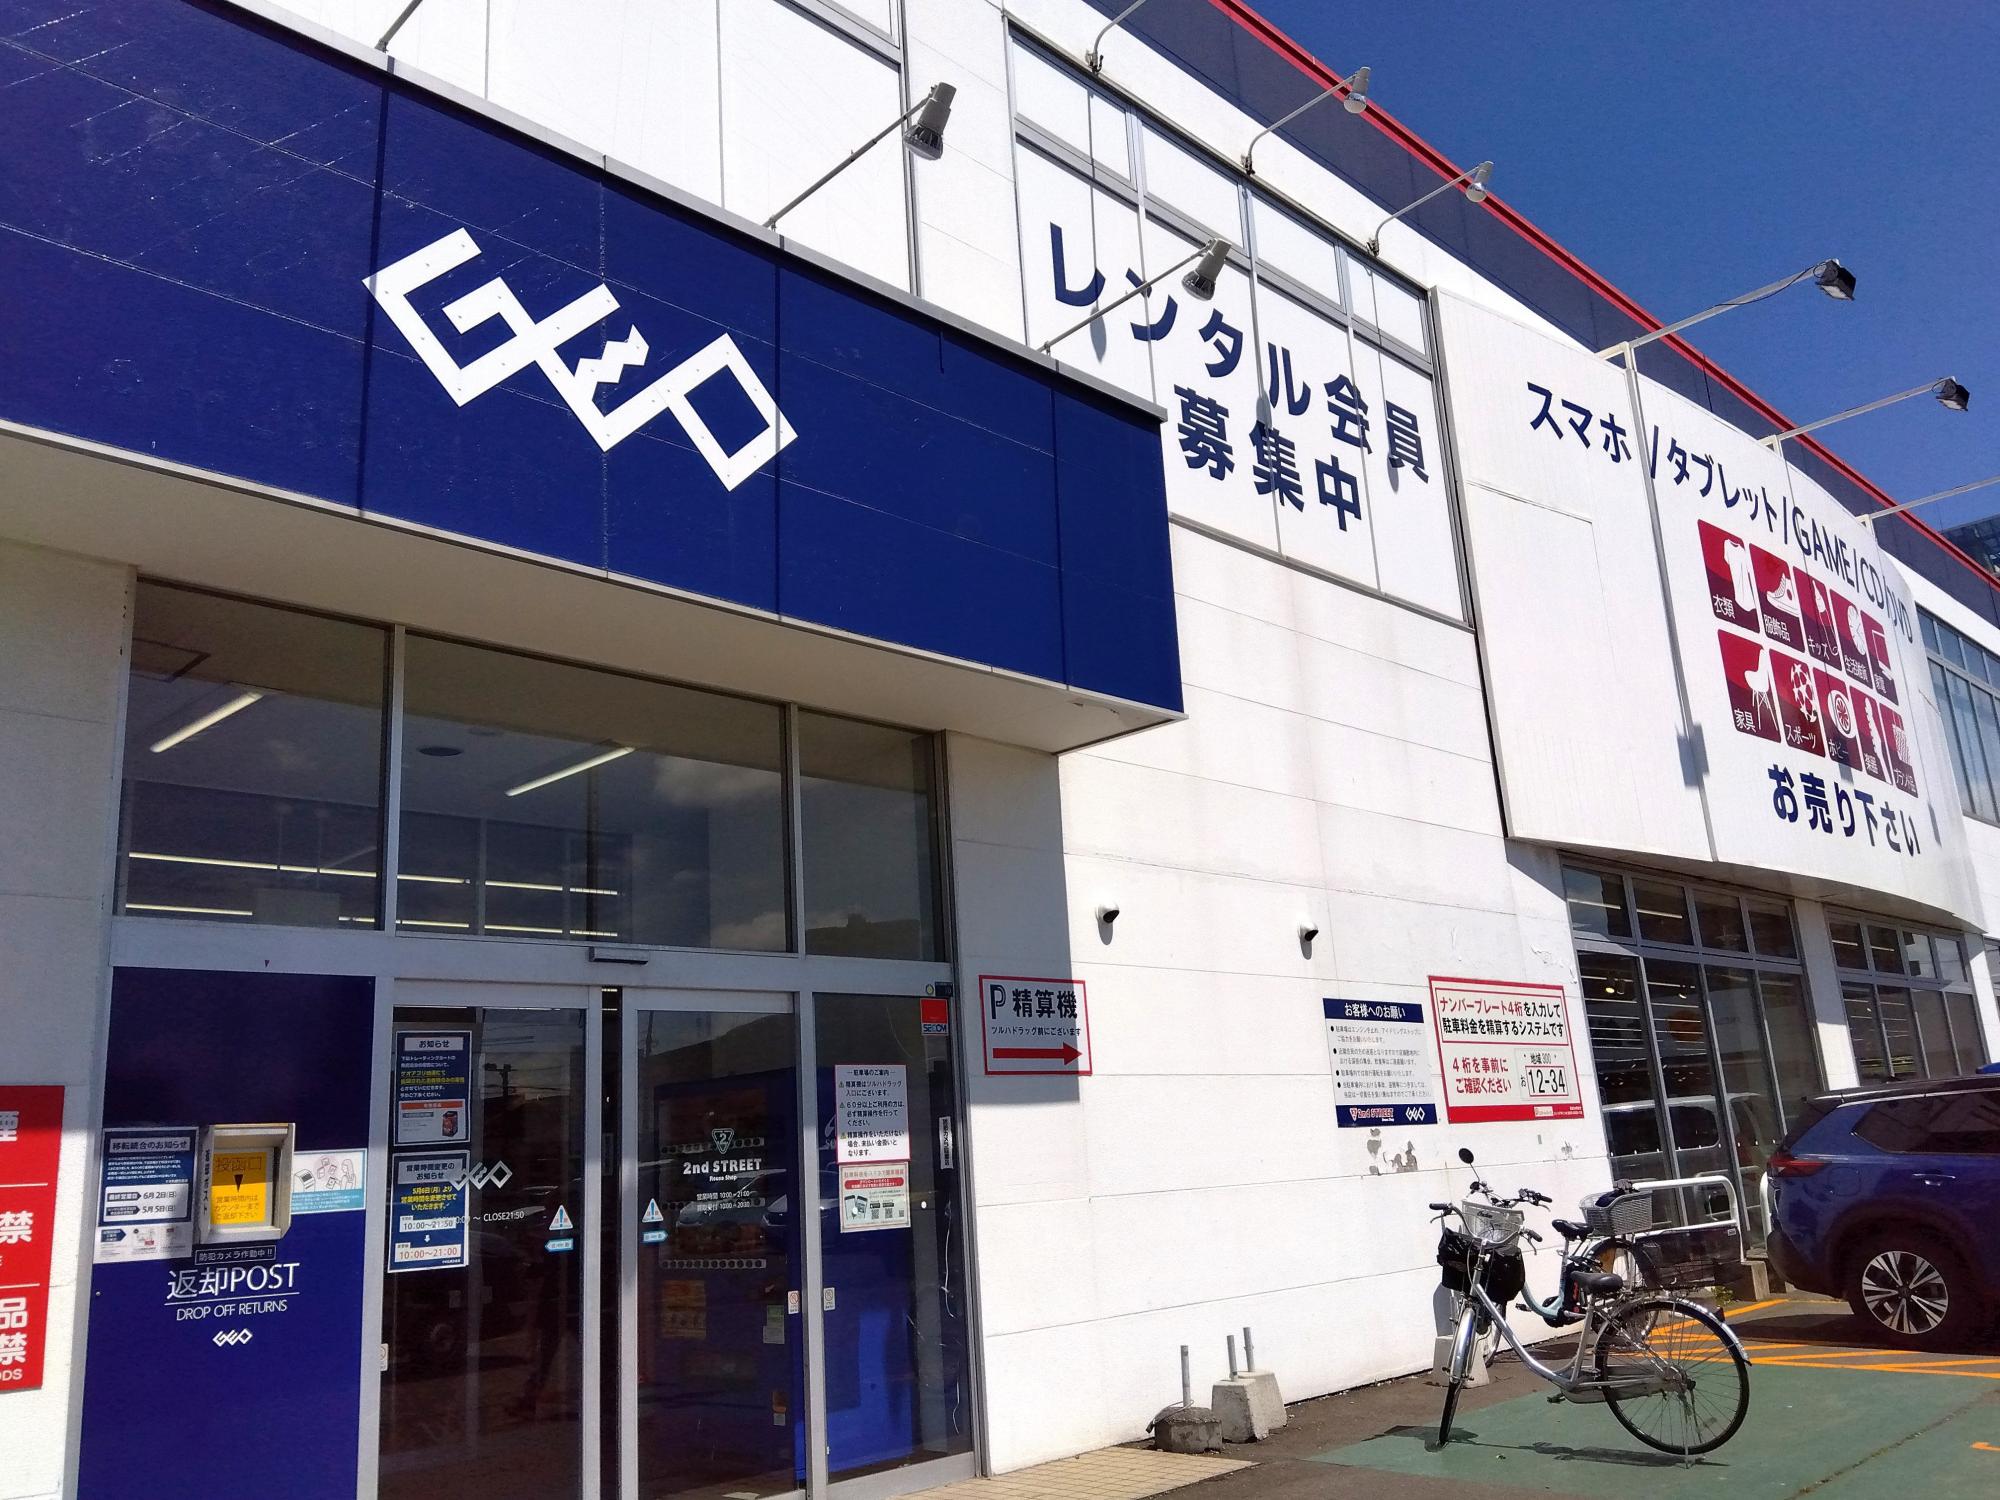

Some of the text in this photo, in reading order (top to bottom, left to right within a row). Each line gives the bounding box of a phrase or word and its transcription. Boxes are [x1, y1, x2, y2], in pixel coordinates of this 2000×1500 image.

[361, 227, 798, 492] GEO
[1050, 222, 1429, 483] レンタル会員
[1173, 383, 1363, 532] 募集中
[1713, 594, 1736, 620] 衣類
[1763, 614, 1791, 643] 服飾品
[1807, 636, 1830, 661] キッズ
[1734, 708, 1757, 733] 家具
[1785, 723, 1817, 750] スポーツ
[1828, 738, 1849, 761] ホビー
[1767, 763, 1922, 857] お売り下さい
[1345, 1003, 1406, 1019] お客様へのお願い
[1439, 996, 1561, 1018] ナンバープレート4桁を入力して
[991, 1026, 1081, 1036] ツルハドラッグ前にございます
[1442, 1017, 1564, 1037] 駐車料金を精算するシステムです
[419, 1040, 450, 1048] お知らせ
[1456, 1078, 1512, 1094] ご確認ください
[1528, 1069, 1566, 1093] 12-34
[1405, 1106, 1426, 1121] GEO
[416, 1172, 444, 1181] お知らせ
[683, 1158, 762, 1175] 2nd STREET
[166, 1262, 300, 1300] 返却POST
[176, 1299, 288, 1321] DROP OFF RETURNS
[212, 1328, 254, 1347] GEO
[0, 1368, 23, 1382] DS
